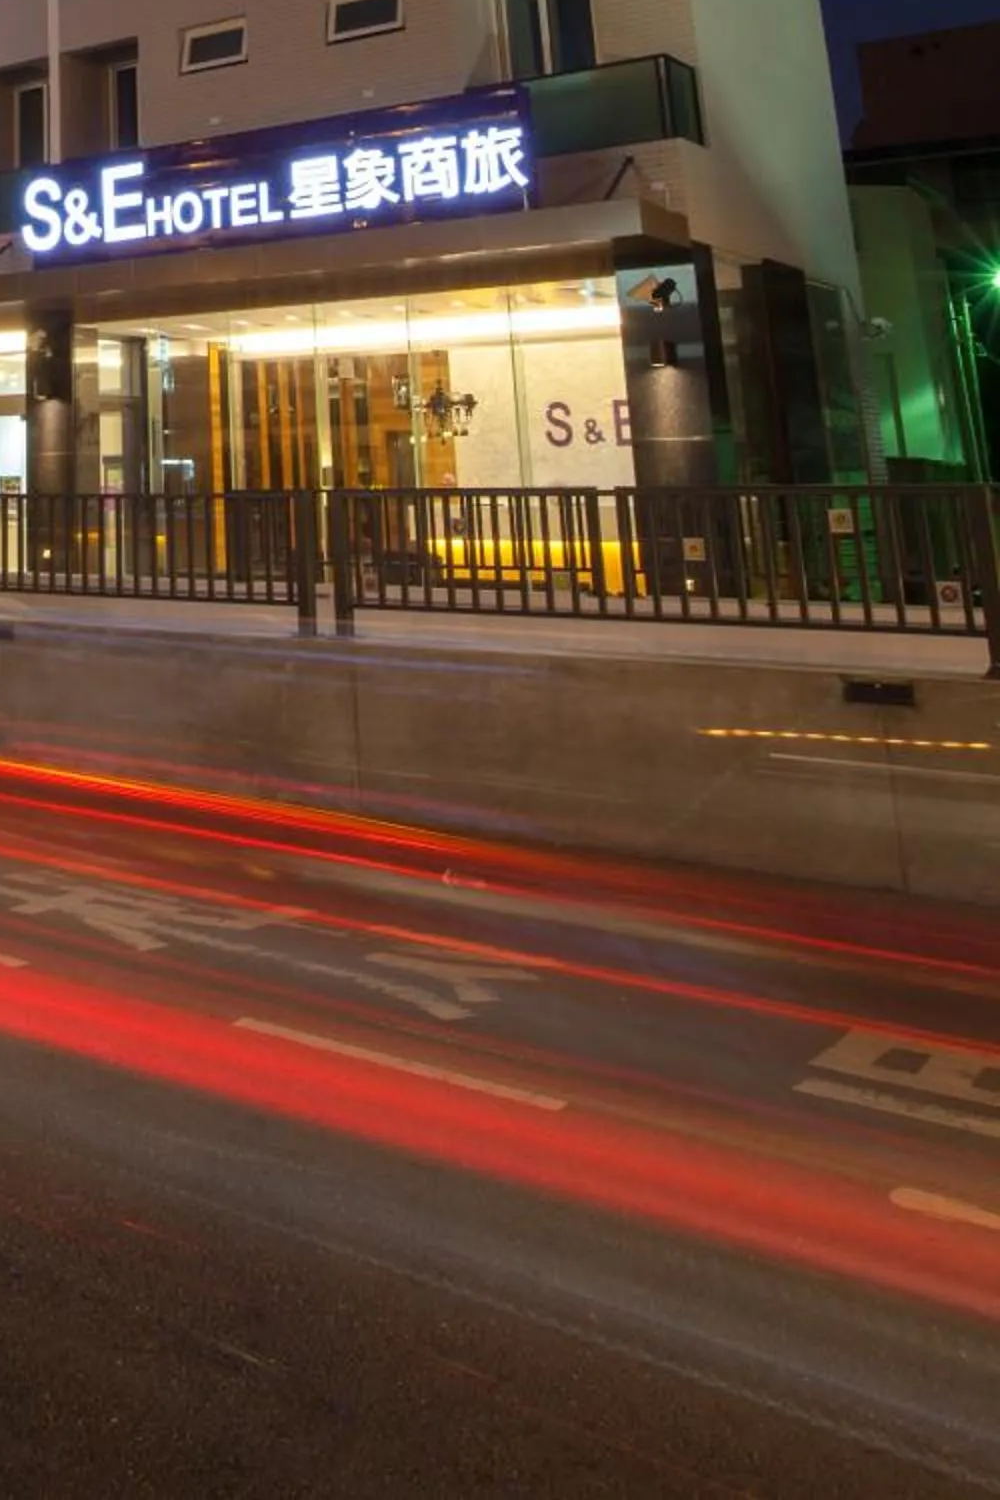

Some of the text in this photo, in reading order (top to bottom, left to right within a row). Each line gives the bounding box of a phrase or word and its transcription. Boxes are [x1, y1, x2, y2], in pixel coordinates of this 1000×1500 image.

[21, 126, 529, 252] S&E HOTEL 星象商旅
